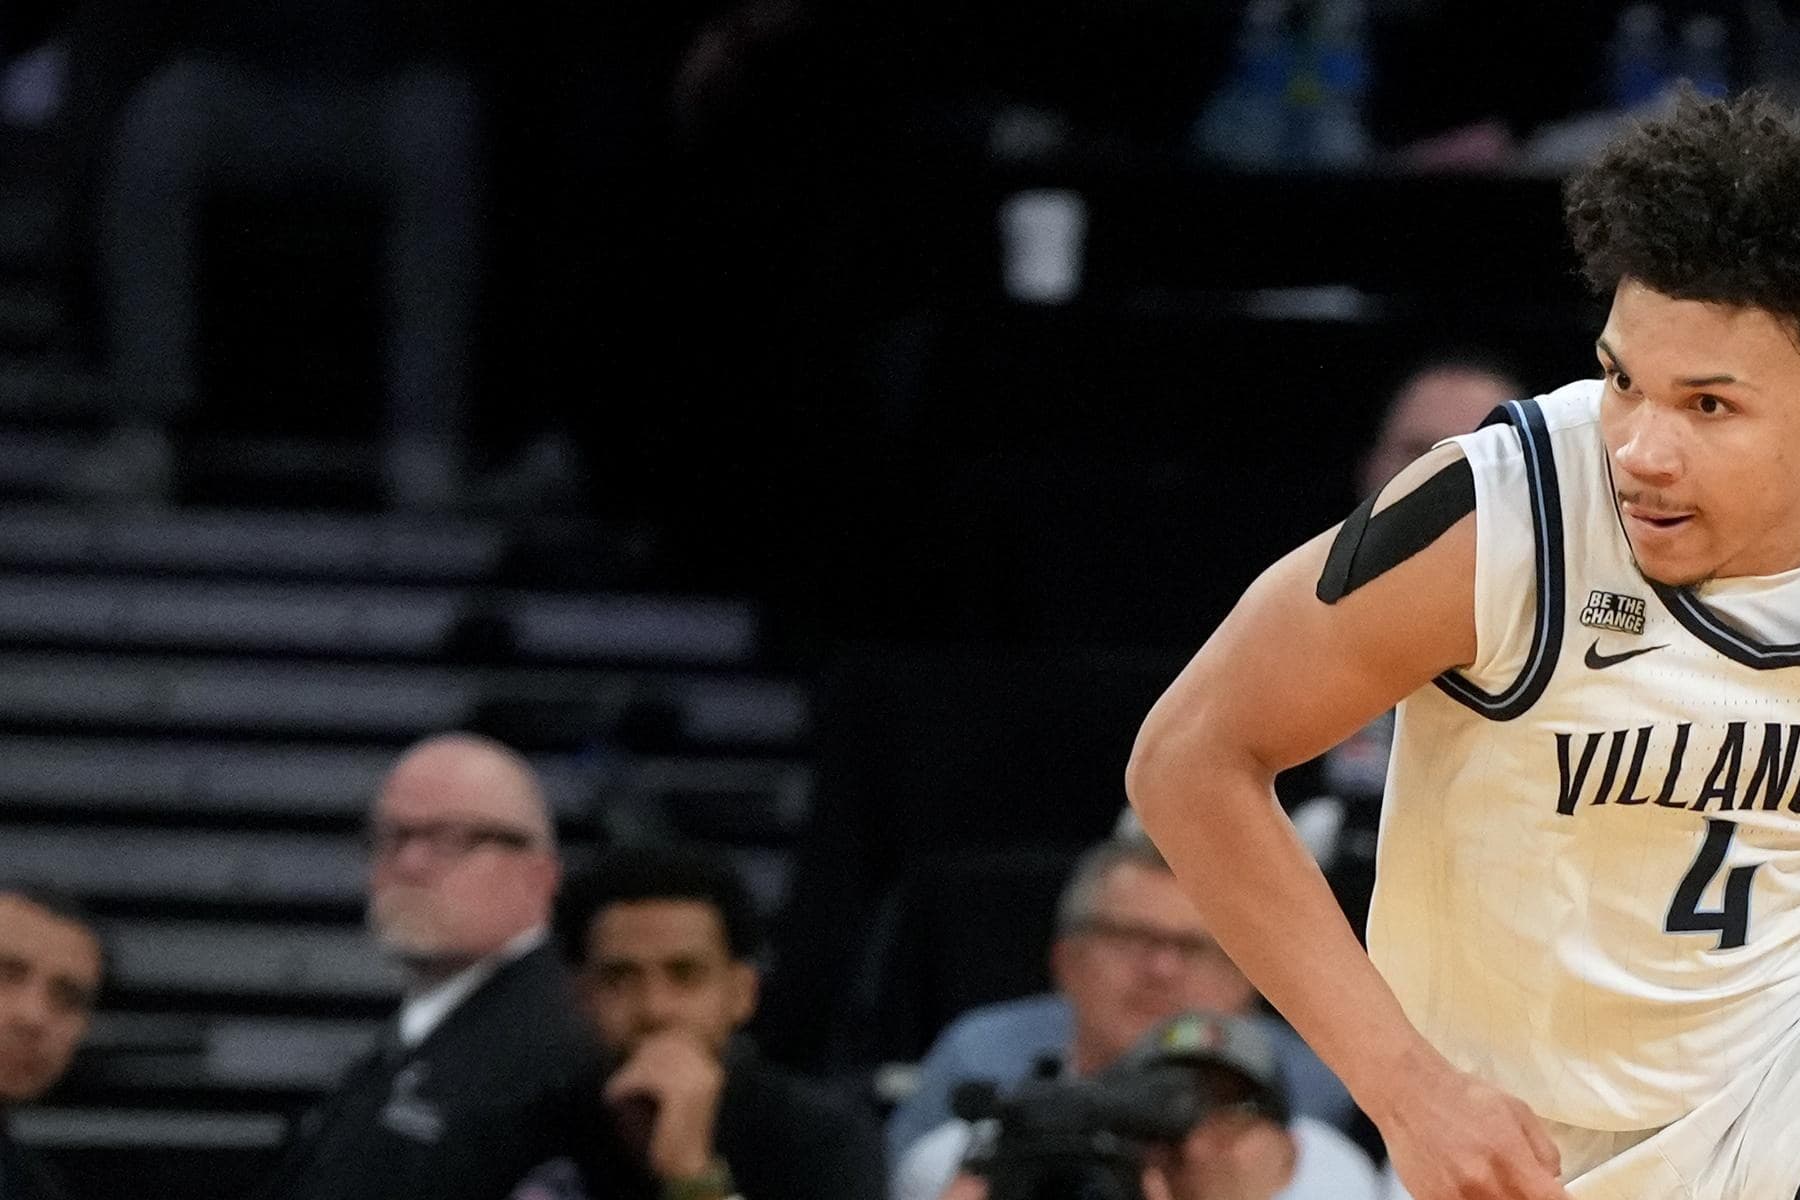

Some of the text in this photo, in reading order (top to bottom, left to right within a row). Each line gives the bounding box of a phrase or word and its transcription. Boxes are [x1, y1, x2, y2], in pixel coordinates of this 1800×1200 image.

[1589, 592, 1644, 616] BE THE
[1581, 607, 1644, 632] CHANGE
[1662, 815, 1768, 951] 4
